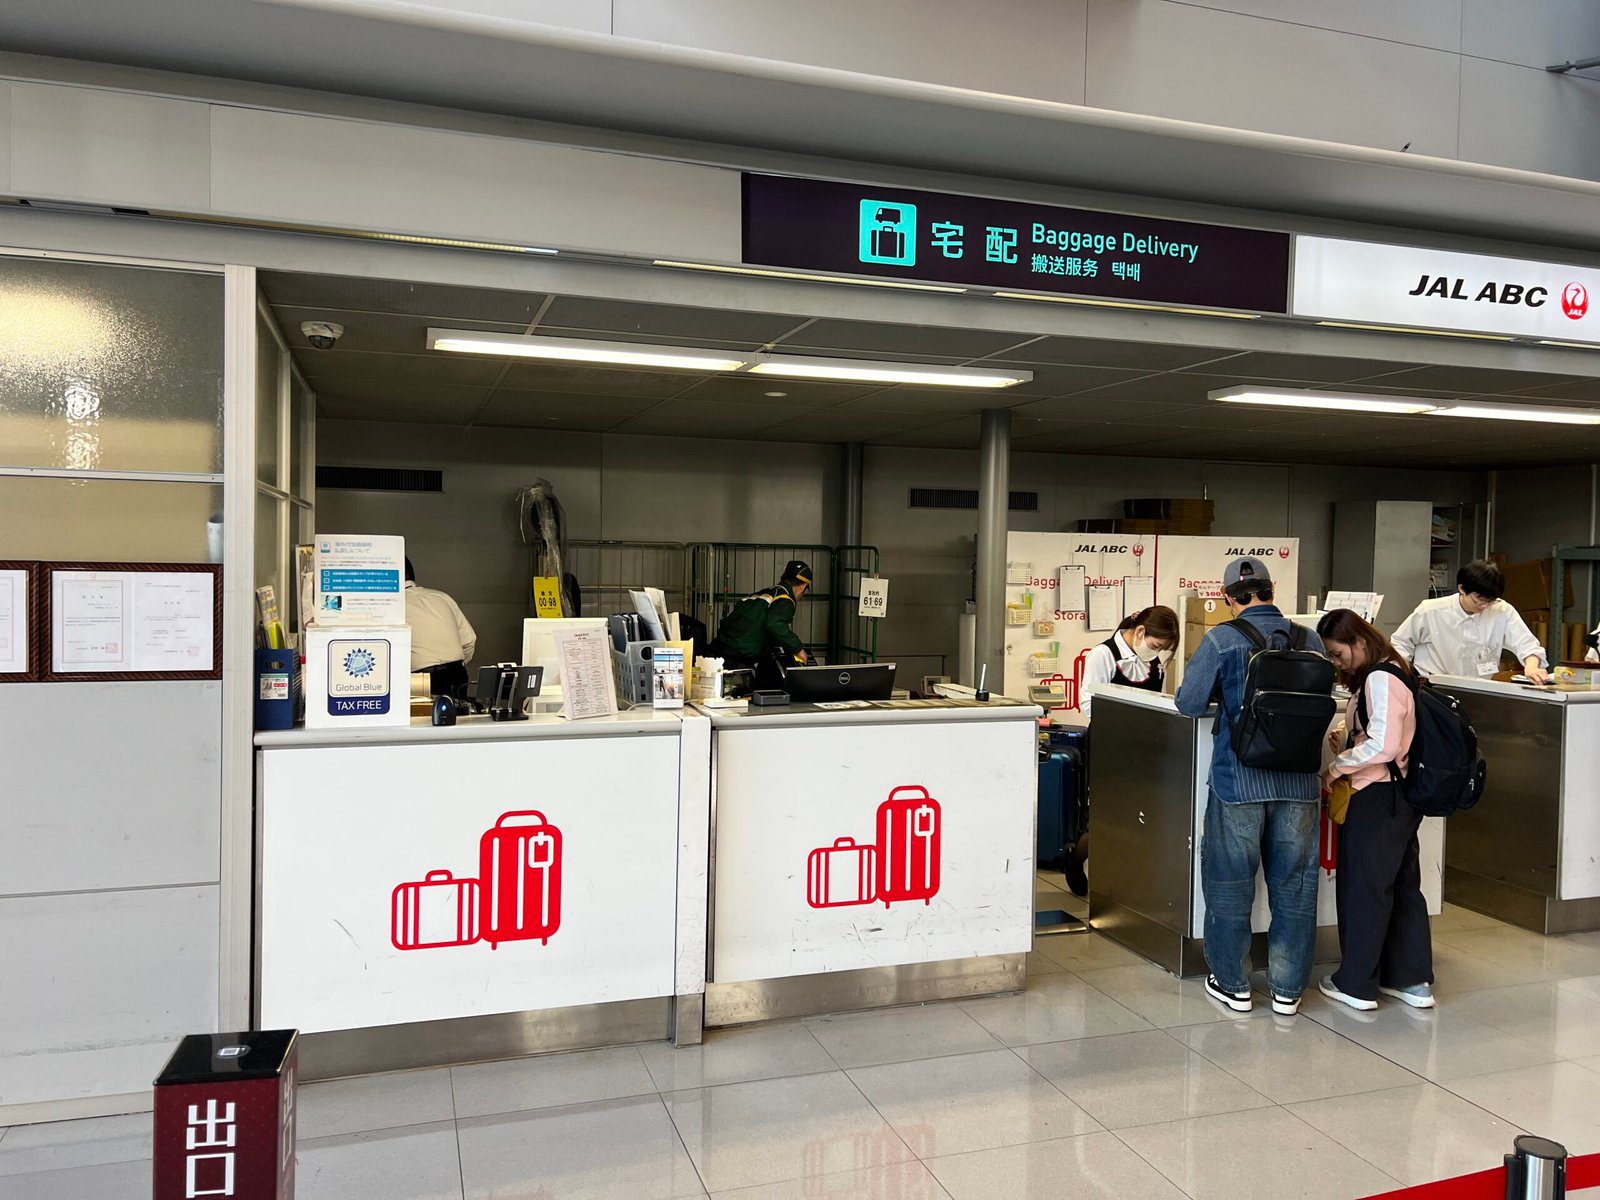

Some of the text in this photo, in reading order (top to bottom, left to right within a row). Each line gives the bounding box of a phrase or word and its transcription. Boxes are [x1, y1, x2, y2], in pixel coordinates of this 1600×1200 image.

[931, 220, 1018, 264] 宅配
[1031, 223, 1199, 264] Baggage Delivery
[1031, 253, 1098, 279] 搬送服务
[1112, 261, 1141, 282] 택배
[1409, 275, 1548, 308] JAL ABC
[1567, 308, 1583, 316] JAL
[1075, 545, 1097, 553] JAL
[1100, 545, 1128, 554] ABC
[1225, 548, 1275, 556] JAL ABC
[1084, 576, 1124, 587] Deliver
[1054, 609, 1086, 621] Stora
[335, 683, 383, 692] Global Blue
[336, 700, 382, 711] TAX FREE
[186, 1099, 236, 1199] 出口
